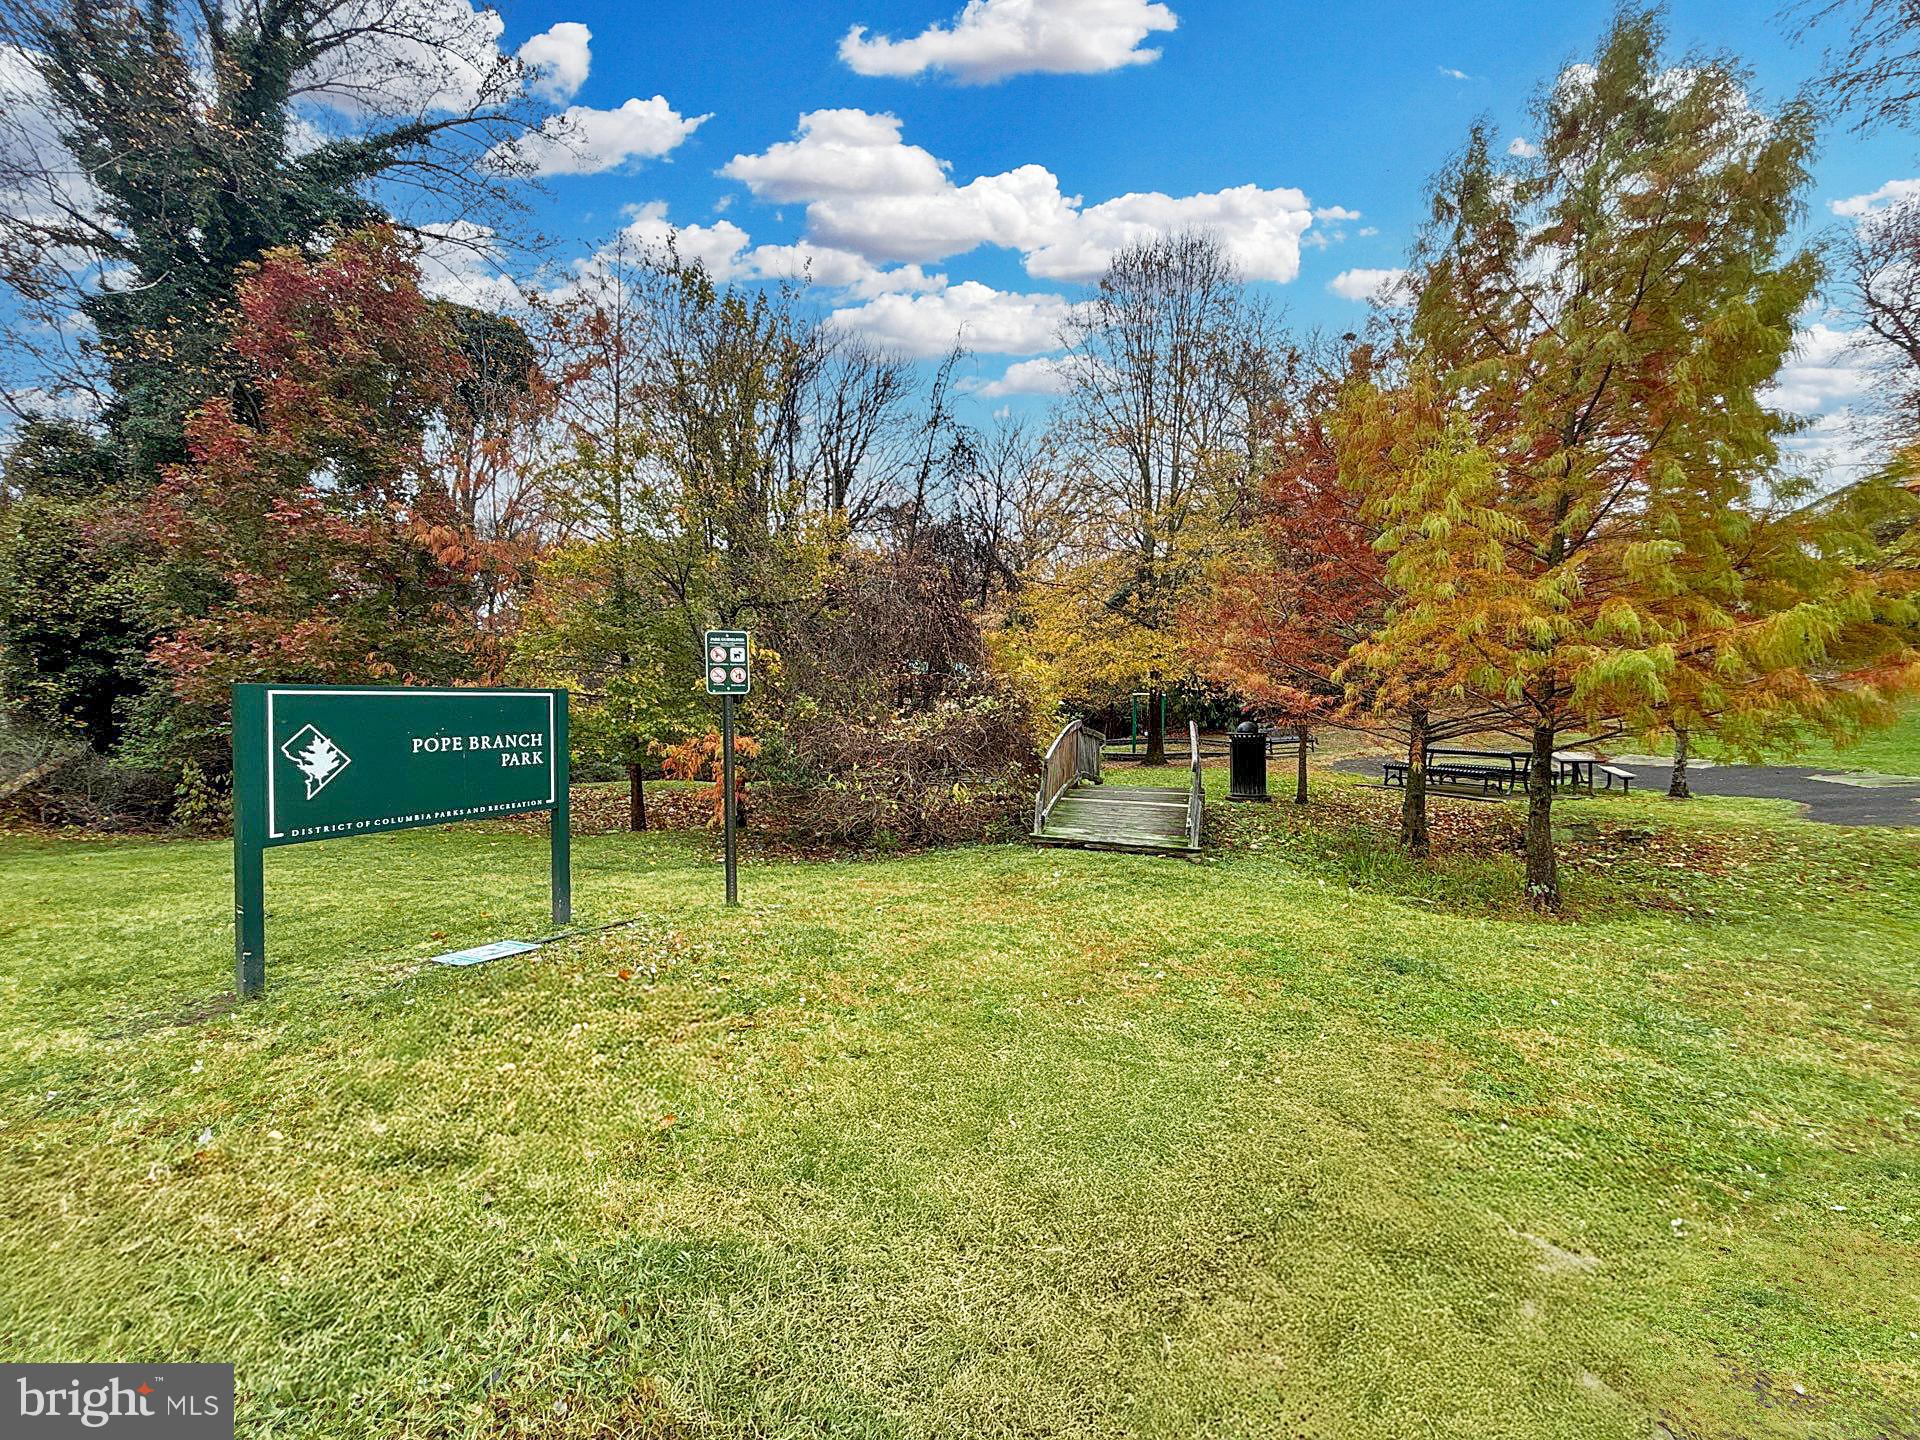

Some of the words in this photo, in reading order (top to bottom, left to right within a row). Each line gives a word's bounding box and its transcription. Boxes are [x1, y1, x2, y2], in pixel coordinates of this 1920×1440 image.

[412, 737, 463, 753] POPE
[468, 733, 543, 750] BRANCH
[501, 751, 544, 767] PARK
[291, 823, 352, 837] DISTRICT
[356, 820, 371, 829] OF
[374, 813, 432, 826] COLUMBIA
[434, 809, 464, 819] PARKS
[466, 806, 486, 815] AND
[488, 799, 543, 812] RECREATION
